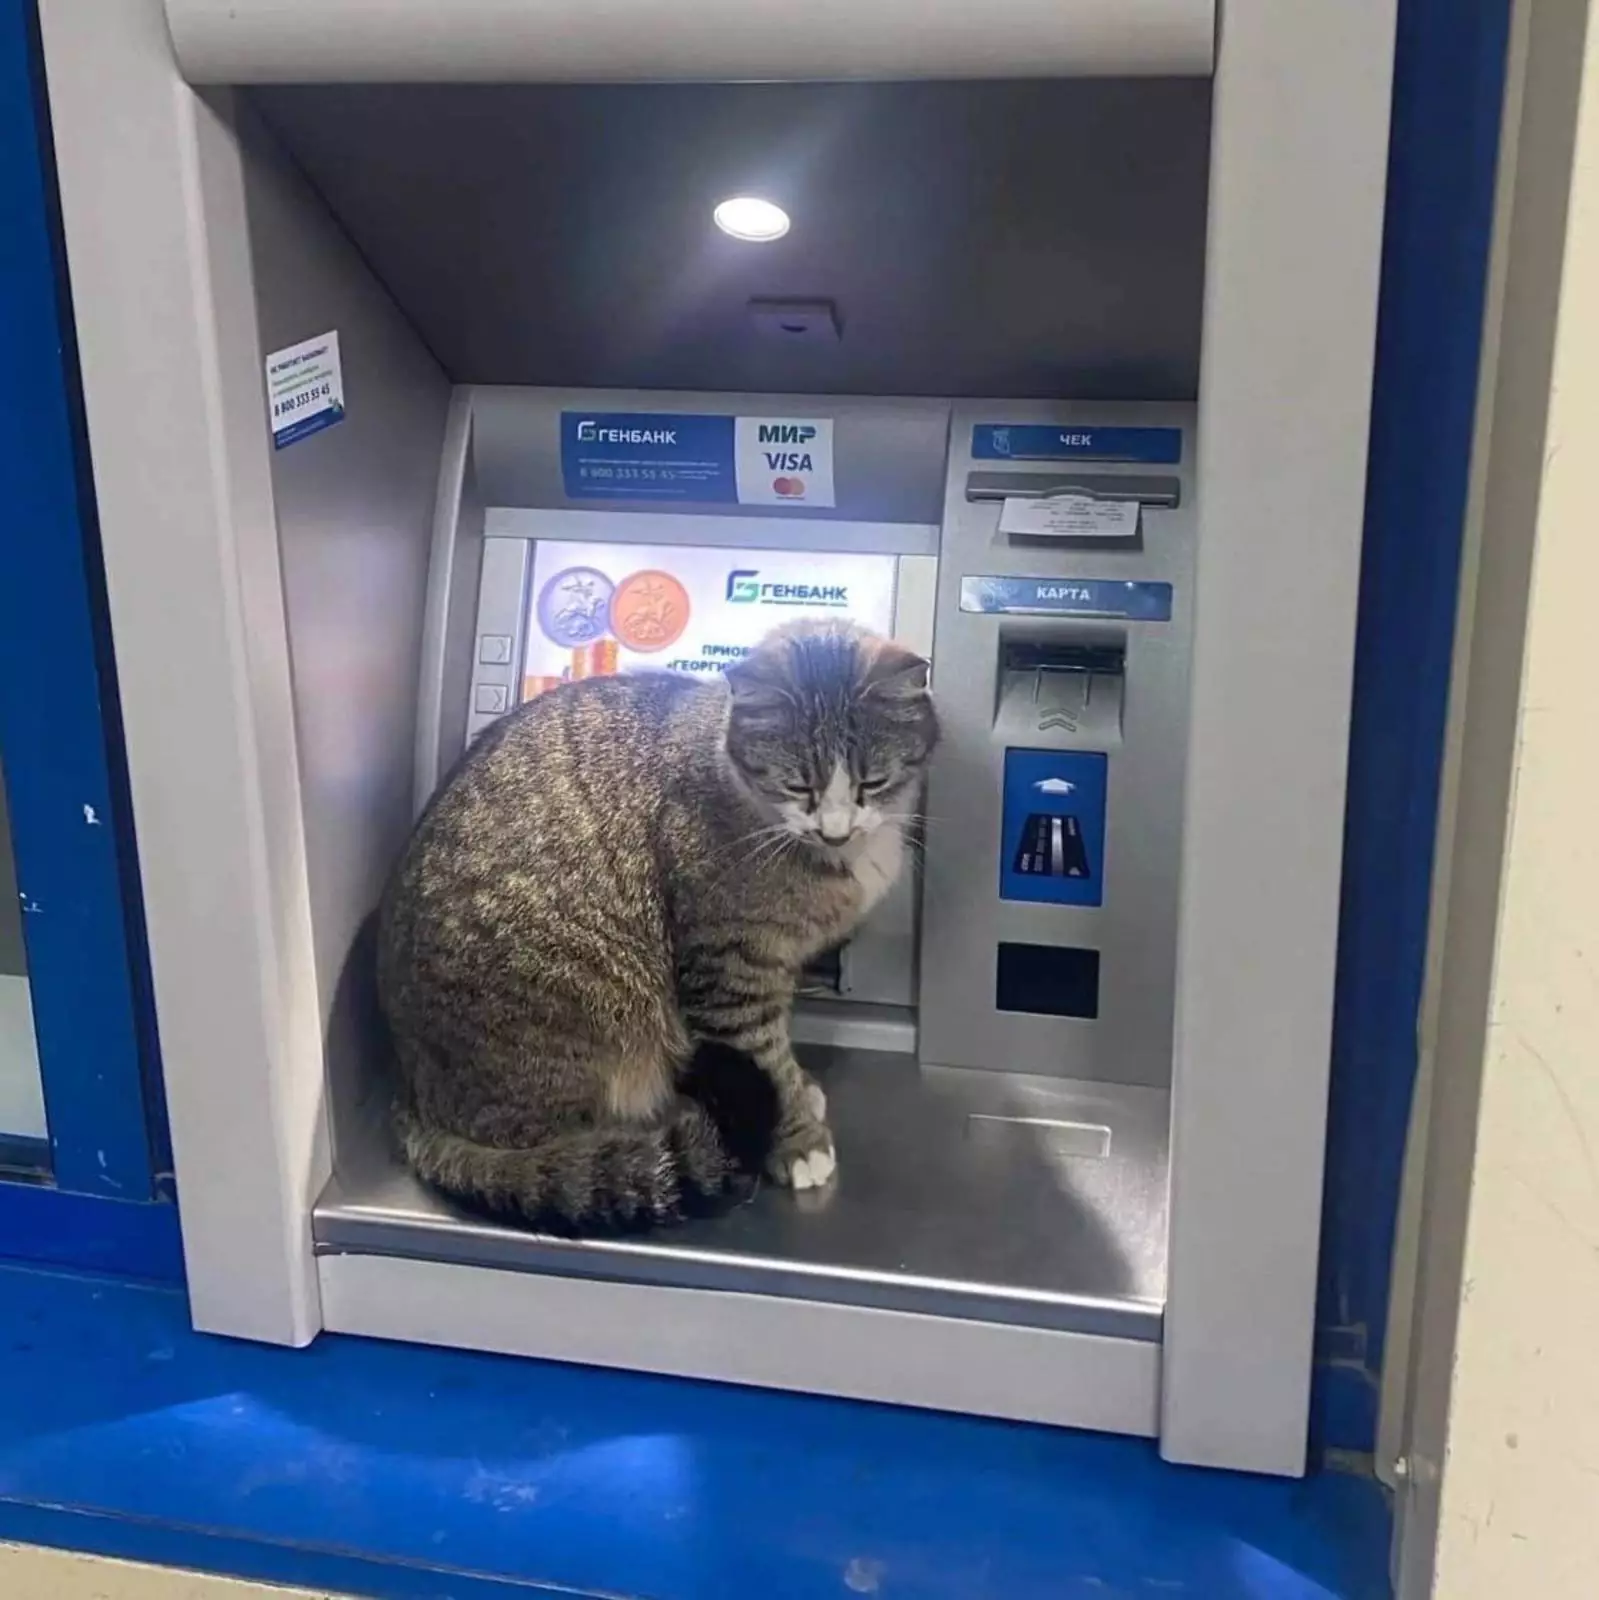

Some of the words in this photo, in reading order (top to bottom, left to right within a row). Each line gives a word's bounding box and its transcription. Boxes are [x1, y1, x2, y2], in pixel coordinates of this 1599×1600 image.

[274, 404, 280, 417] 8
[281, 397, 296, 414] 800
[296, 391, 310, 408] 333
[598, 428, 677, 446] ГЕНБАНК
[758, 424, 816, 444] МИР
[1059, 434, 1092, 446] ЧЕК
[762, 452, 813, 472] VISA
[761, 583, 848, 600] ГЕНБАНК
[1036, 586, 1091, 601] КАРТА
